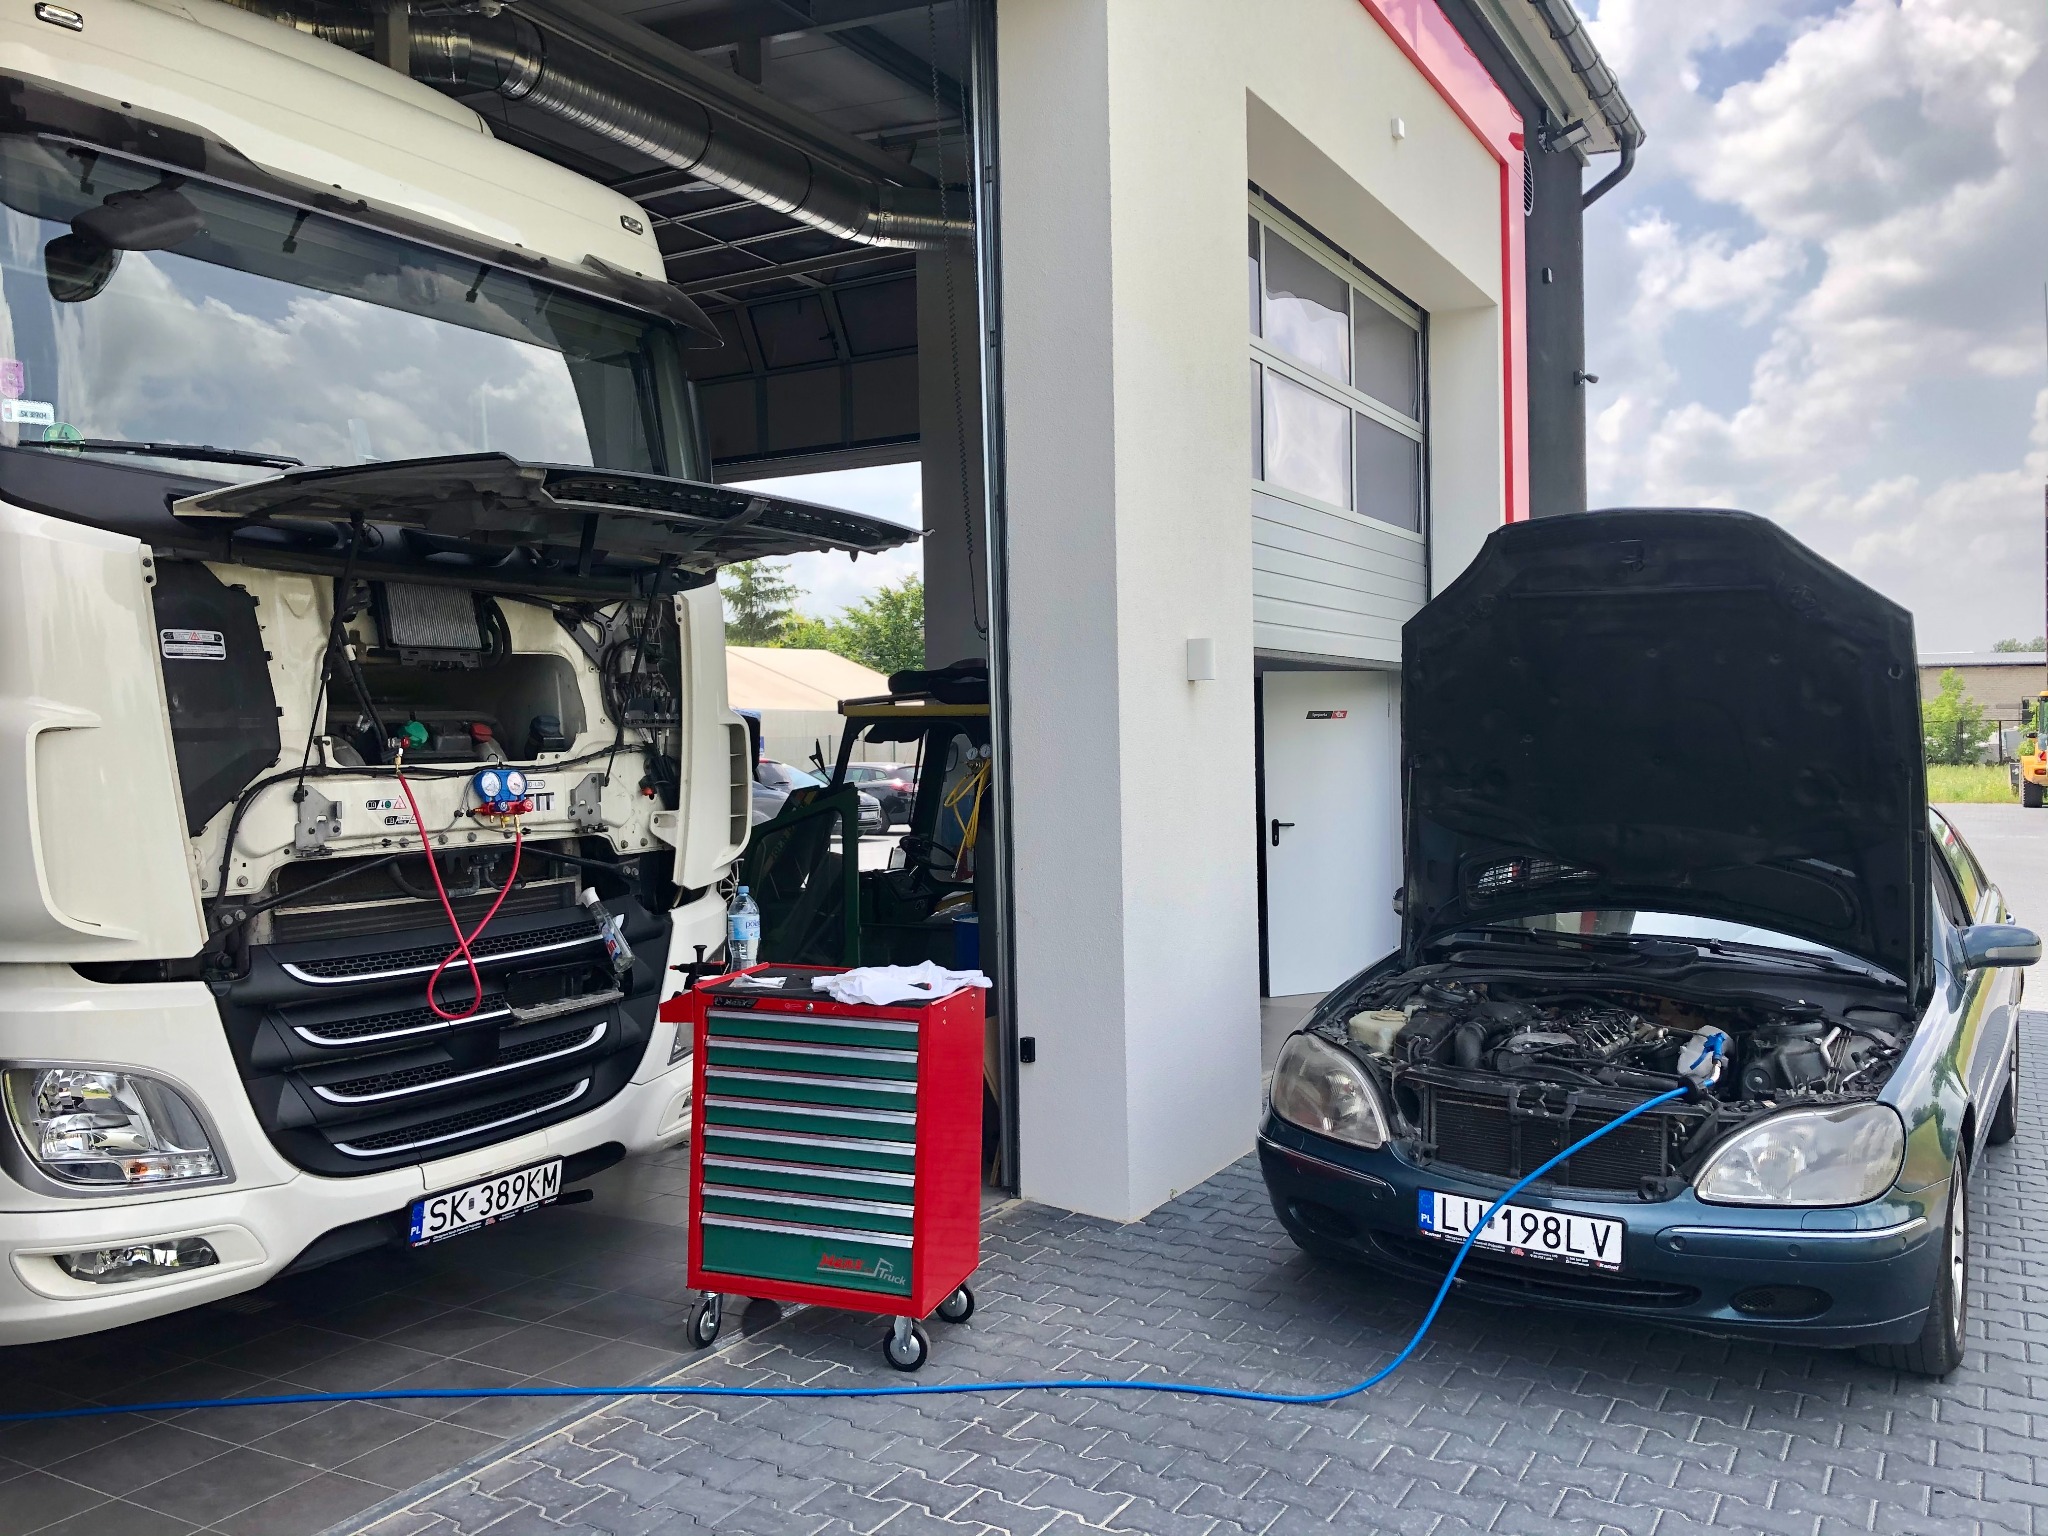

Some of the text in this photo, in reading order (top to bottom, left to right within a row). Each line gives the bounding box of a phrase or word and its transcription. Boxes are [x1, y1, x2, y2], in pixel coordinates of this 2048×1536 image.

[58, 424, 70, 440] 4
[430, 1191, 470, 1232] SK
[479, 1164, 558, 1216] 389KM
[1421, 1213, 1432, 1224] PL
[410, 1226, 421, 1237] PL
[1442, 1197, 1483, 1235] LU
[1501, 1209, 1612, 1259] 198LV
[879, 1267, 906, 1286] Truck
